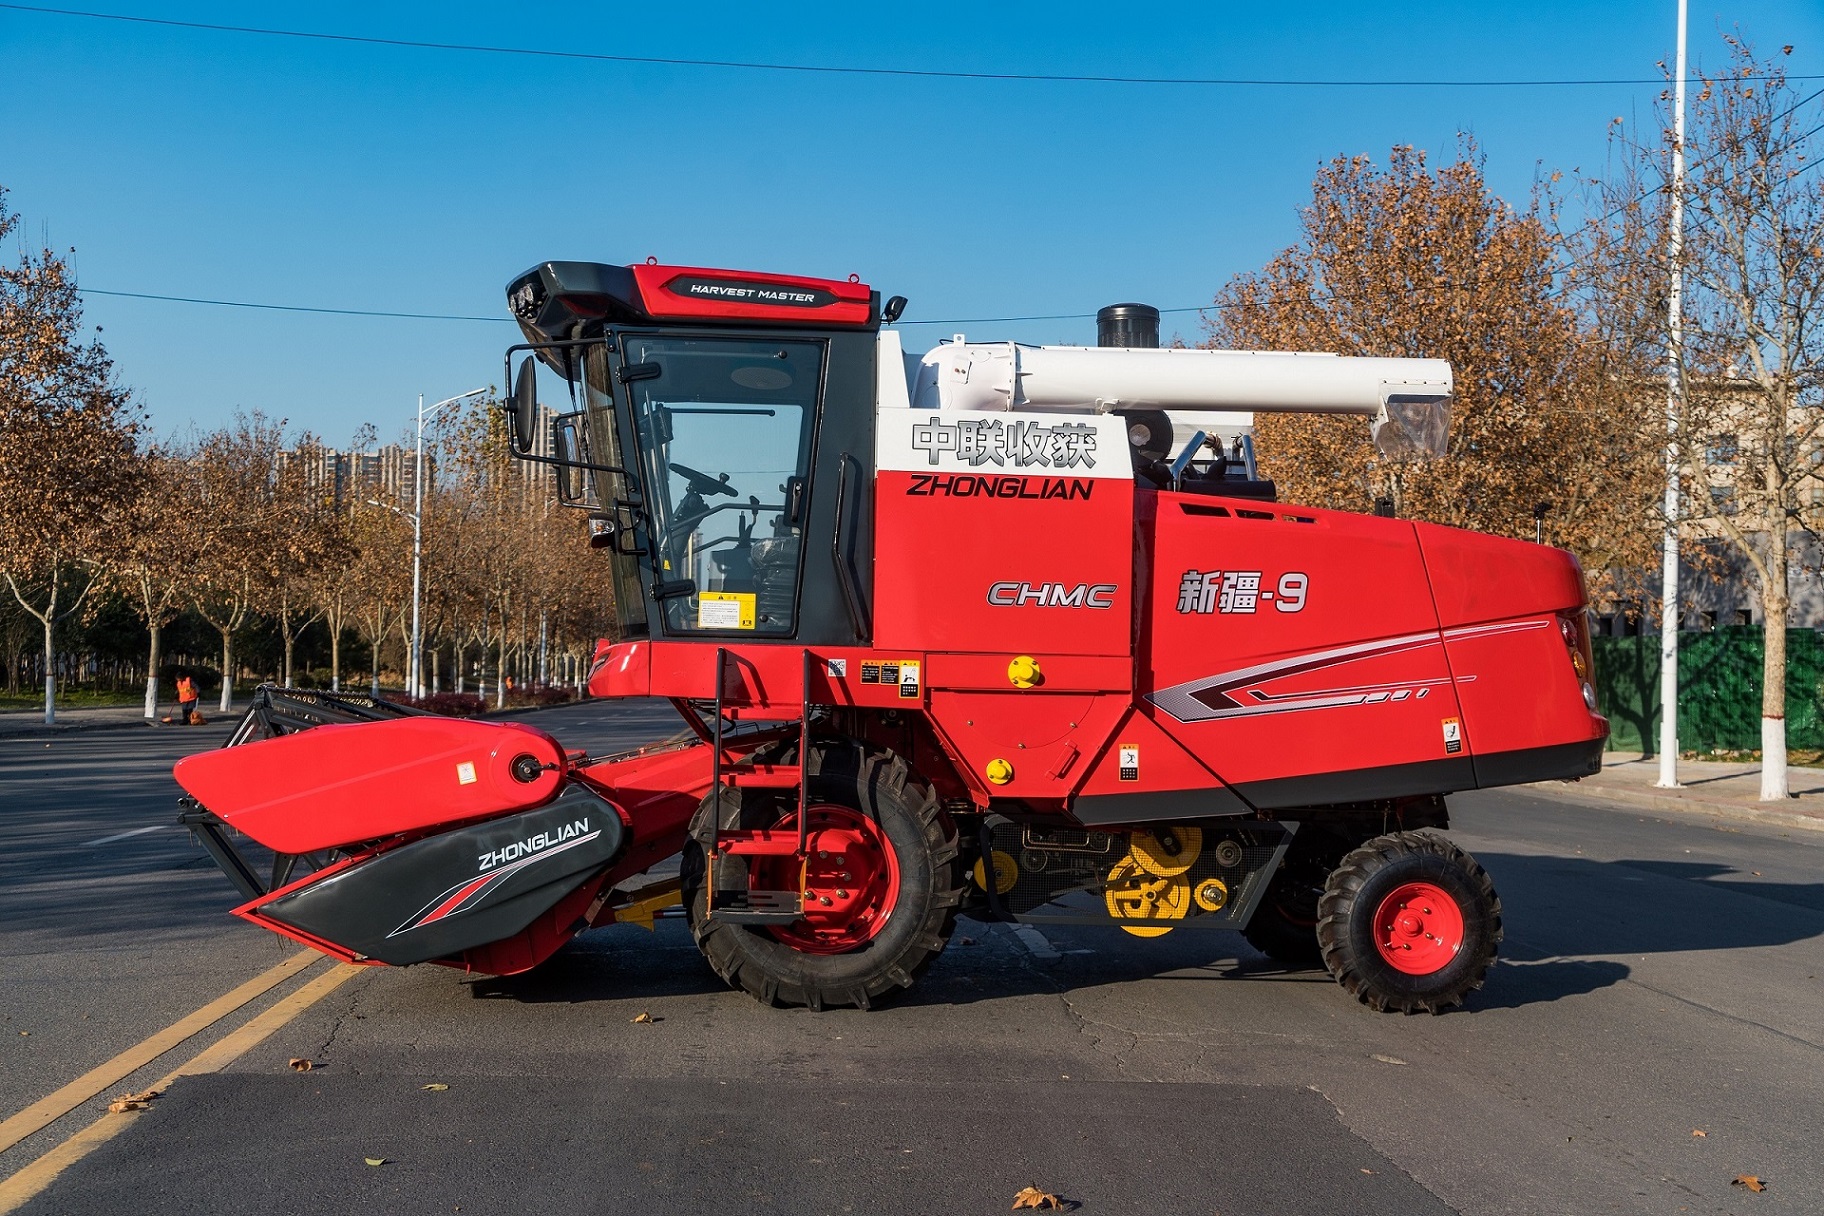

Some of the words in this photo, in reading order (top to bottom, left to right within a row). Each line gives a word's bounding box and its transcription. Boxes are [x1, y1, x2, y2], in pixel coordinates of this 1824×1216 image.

[690, 284, 756, 297] HARVEST
[757, 290, 815, 303] MASTER
[911, 416, 1097, 469] 中联收获
[906, 474, 1095, 501] ZHONGLIAN
[986, 581, 1118, 609] CHMC
[1176, 569, 1309, 614] 新疆-9
[478, 817, 589, 871] ZHONGLIAN
